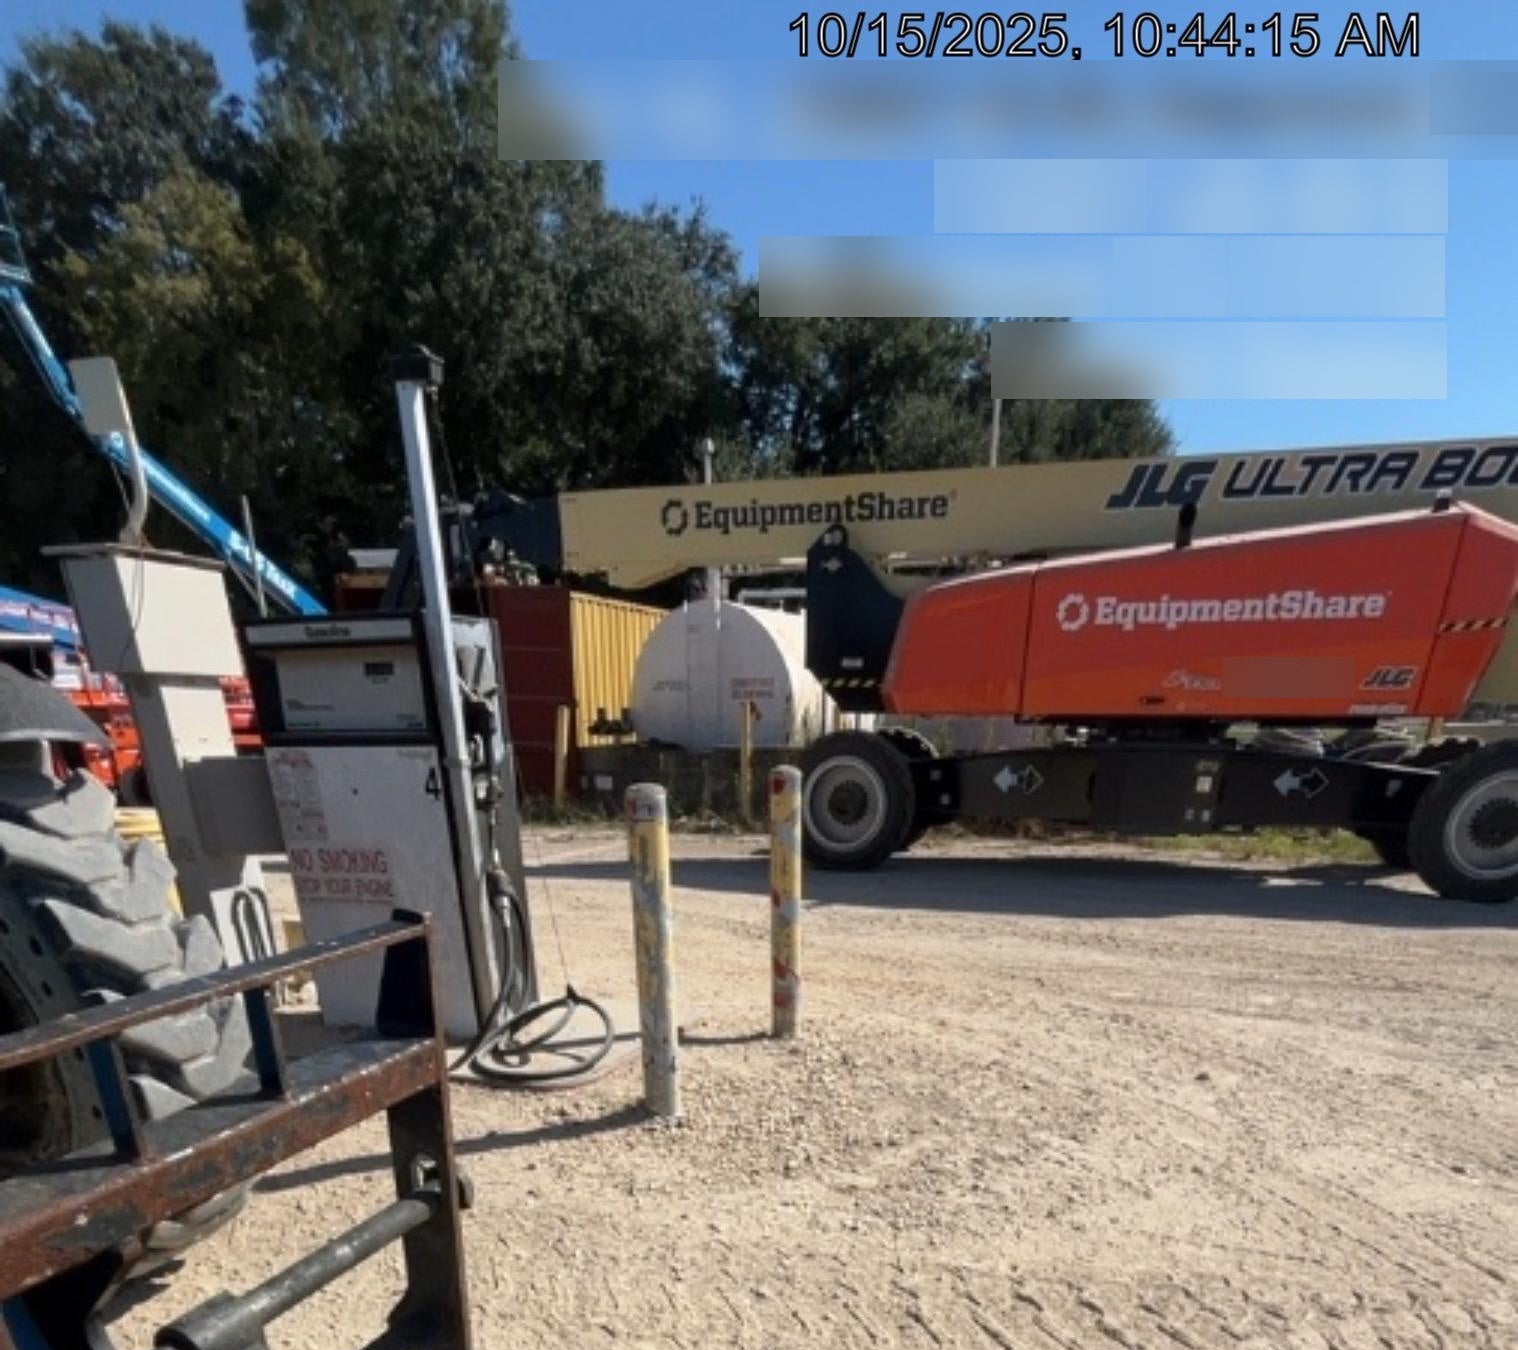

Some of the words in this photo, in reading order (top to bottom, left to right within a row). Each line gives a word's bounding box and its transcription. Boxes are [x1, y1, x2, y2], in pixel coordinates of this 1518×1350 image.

[1106, 461, 1218, 508] JLG
[1224, 452, 1420, 498] ULTRA
[1420, 447, 1518, 490] BO
[695, 491, 949, 534] EquipmentShare
[1095, 590, 1386, 630] EquipmentShare
[1364, 668, 1415, 687] JLG
[425, 767, 441, 800] 4
[290, 848, 313, 871] NO
[318, 848, 388, 873] SMOKING
